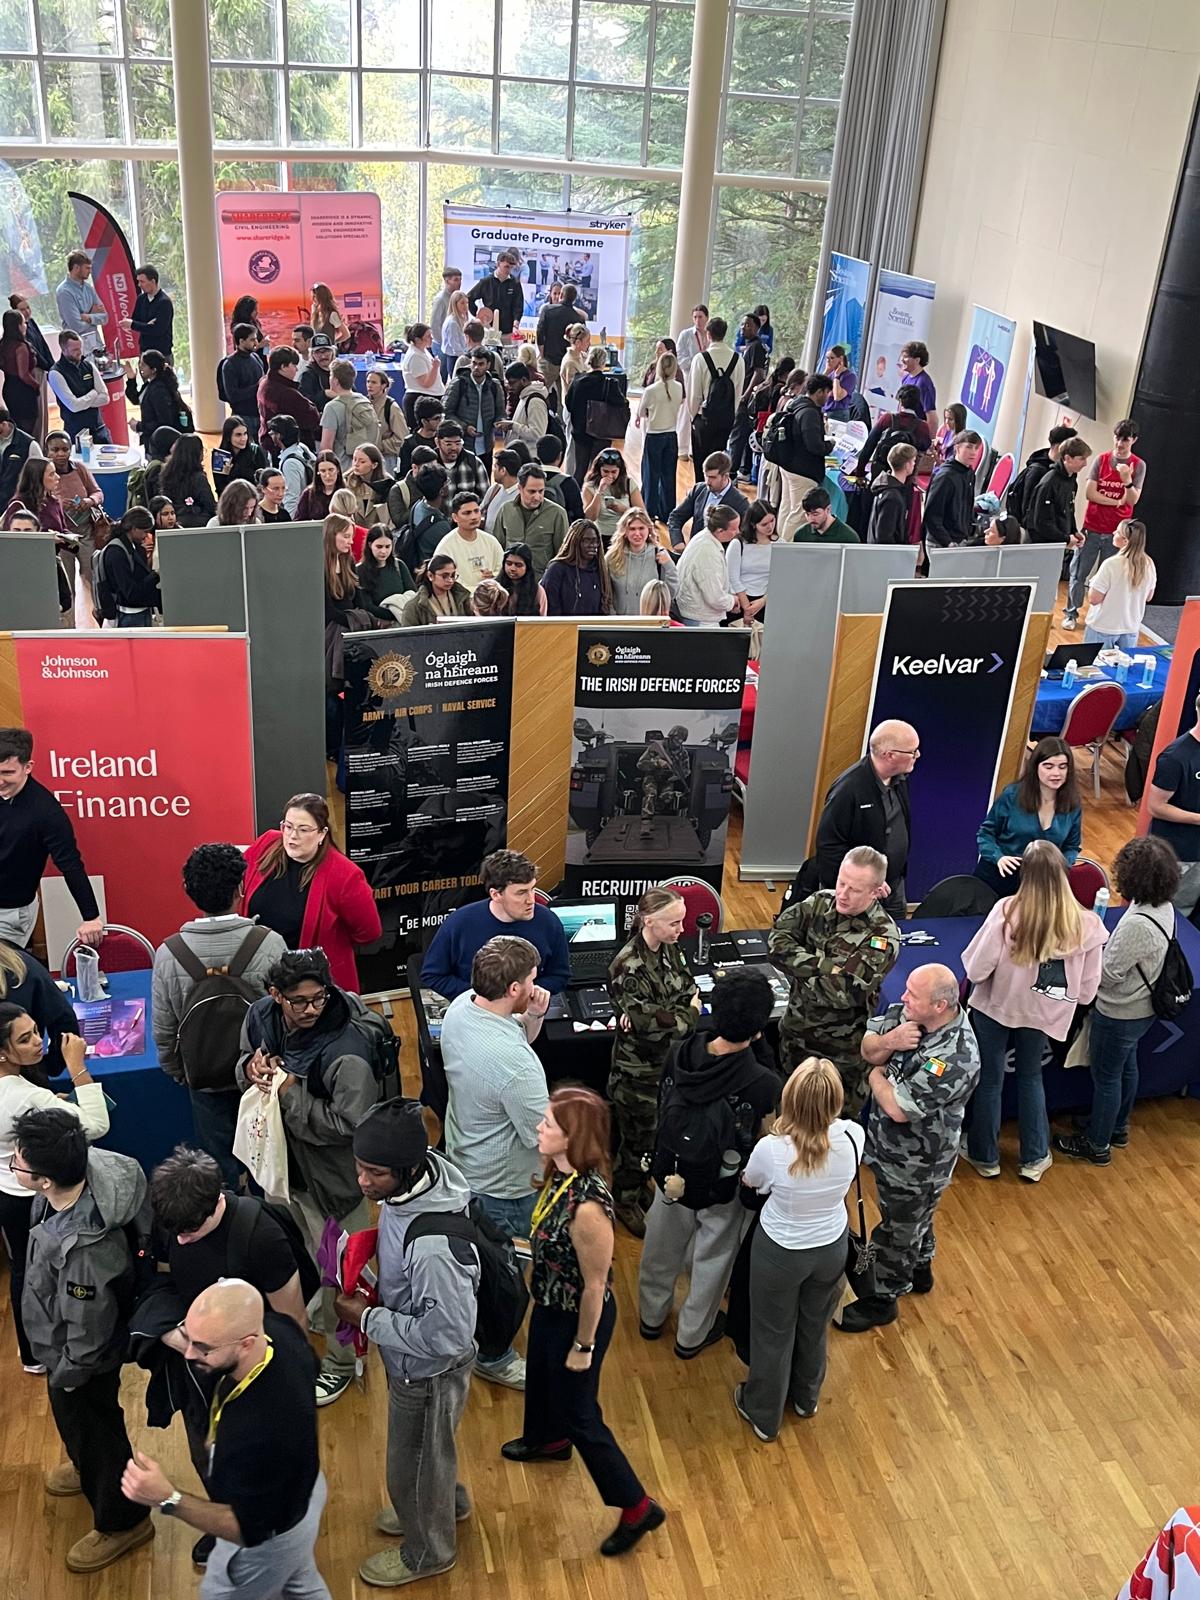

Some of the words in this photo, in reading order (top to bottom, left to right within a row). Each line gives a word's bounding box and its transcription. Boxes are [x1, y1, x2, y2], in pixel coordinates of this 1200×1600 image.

[588, 220, 626, 230] stryker
[471, 228, 530, 242] Graduate
[532, 233, 604, 248] Programme
[118, 293, 136, 350] Neoyne
[888, 310, 915, 326] Scientific
[41, 655, 98, 667] Johnson
[425, 650, 477, 668] Óglaigh
[892, 654, 984, 676] Keelvar
[42, 668, 109, 679] &Johnson
[425, 670, 441, 680] na
[444, 665, 498, 679] hÉireann
[444, 678, 472, 687] DEFENCE
[474, 676, 498, 684] FORCES
[580, 676, 602, 692] THE
[606, 678, 637, 692] IRISH
[640, 678, 693, 692] DEFENCE
[695, 678, 740, 693] FORCES
[362, 710, 385, 722] ARMY
[394, 706, 408, 718] AIR
[408, 704, 433, 716] CORPS
[442, 702, 465, 712] NAVAL
[466, 698, 496, 710] SERVICE
[50, 750, 158, 778] Ireland
[395, 882, 420, 896] YOUR
[422, 878, 458, 892] CAREER
[406, 918, 419, 930] BE
